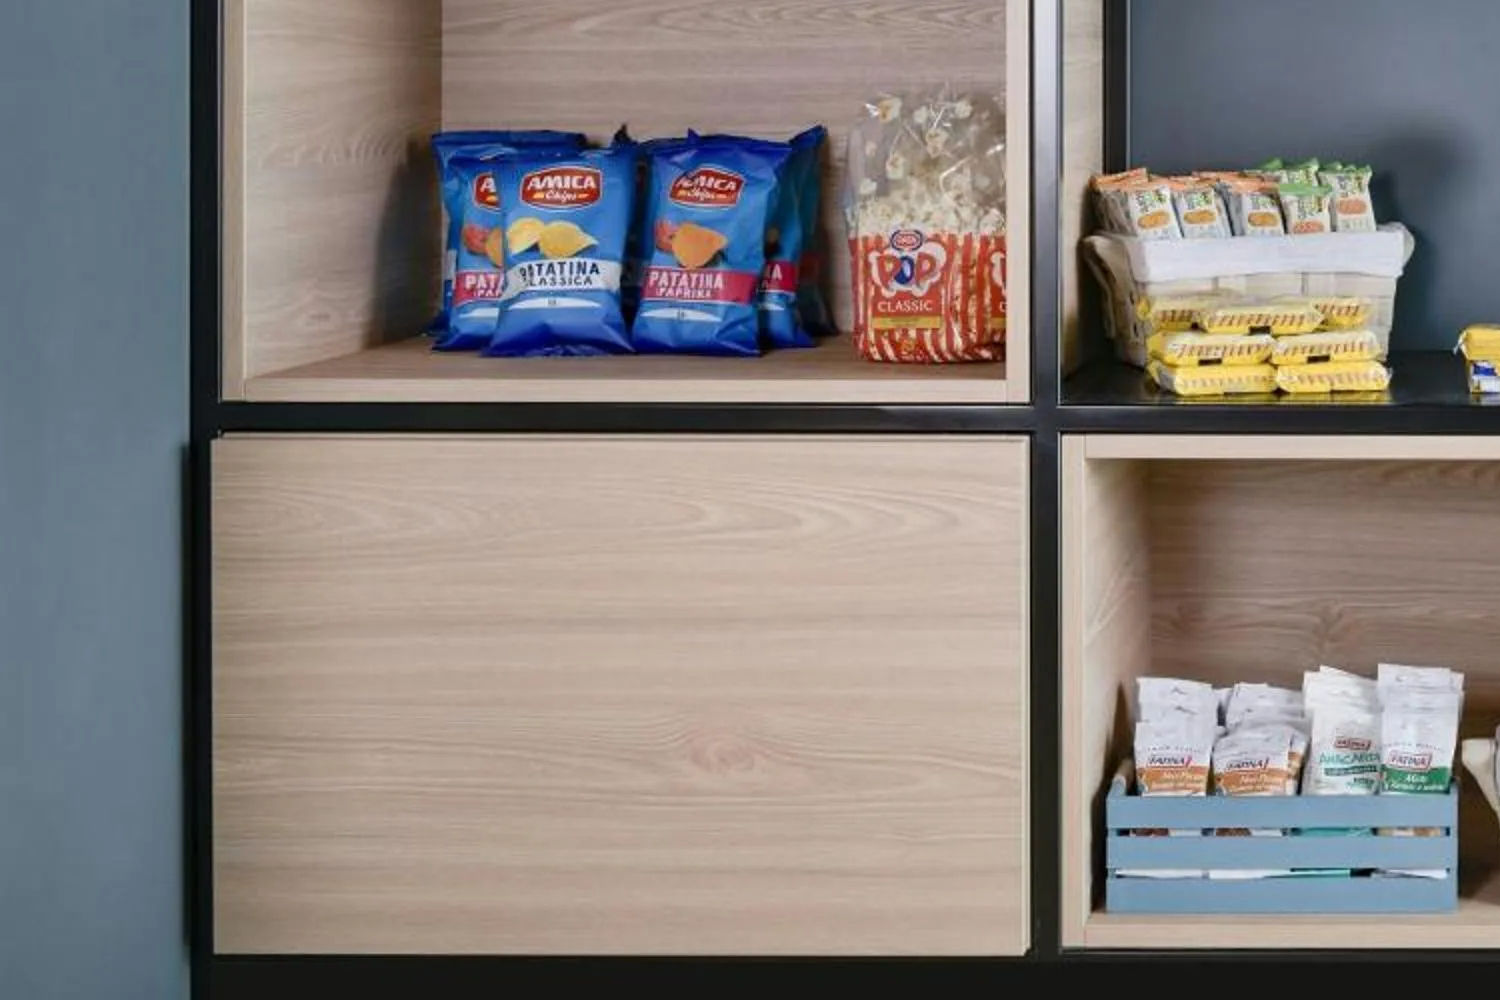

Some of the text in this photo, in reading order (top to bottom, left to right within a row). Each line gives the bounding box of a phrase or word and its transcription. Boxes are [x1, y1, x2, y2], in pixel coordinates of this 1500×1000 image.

[527, 175, 597, 191] AMICA
[648, 271, 724, 289] PATATINA
[877, 300, 933, 313] CLASSIC
